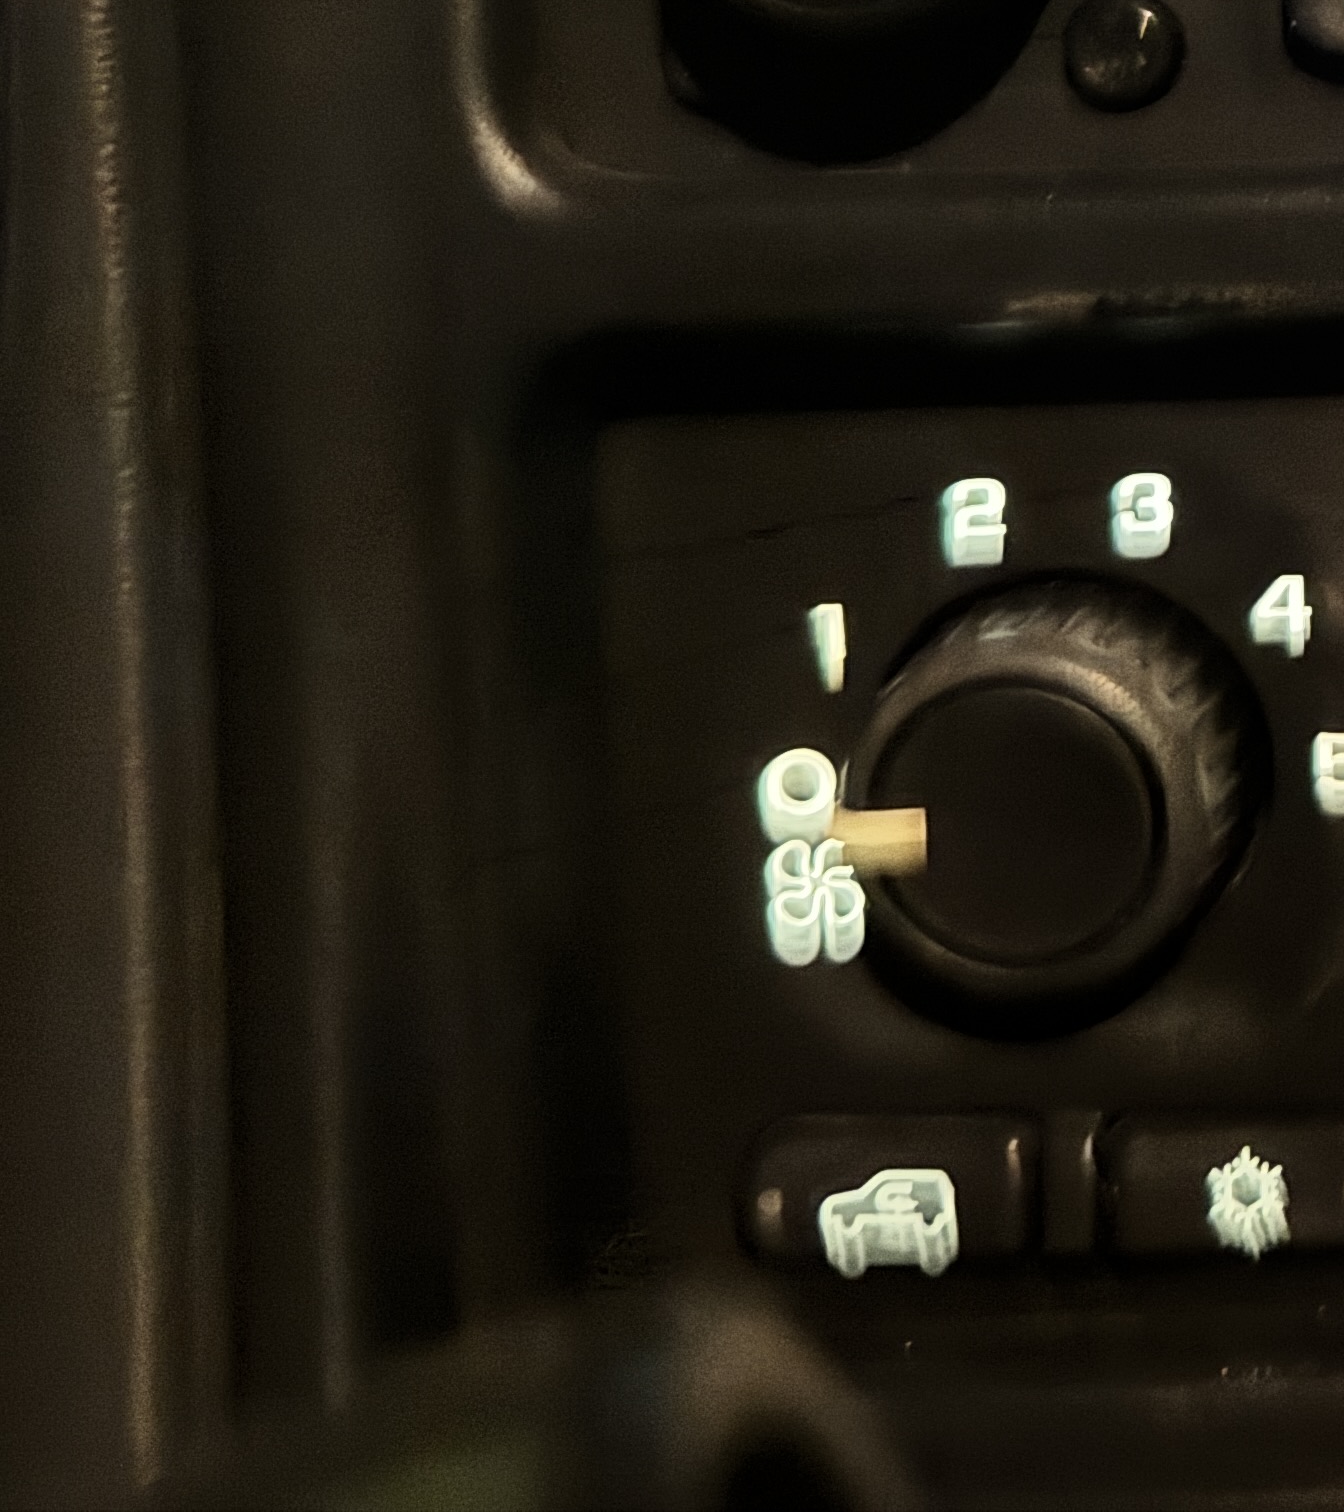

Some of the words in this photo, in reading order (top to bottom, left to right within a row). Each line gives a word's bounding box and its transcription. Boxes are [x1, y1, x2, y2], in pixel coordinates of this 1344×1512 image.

[942, 478, 1007, 567] 2
[1111, 472, 1174, 558] 3
[808, 602, 846, 692] 1
[1249, 575, 1312, 658] 4
